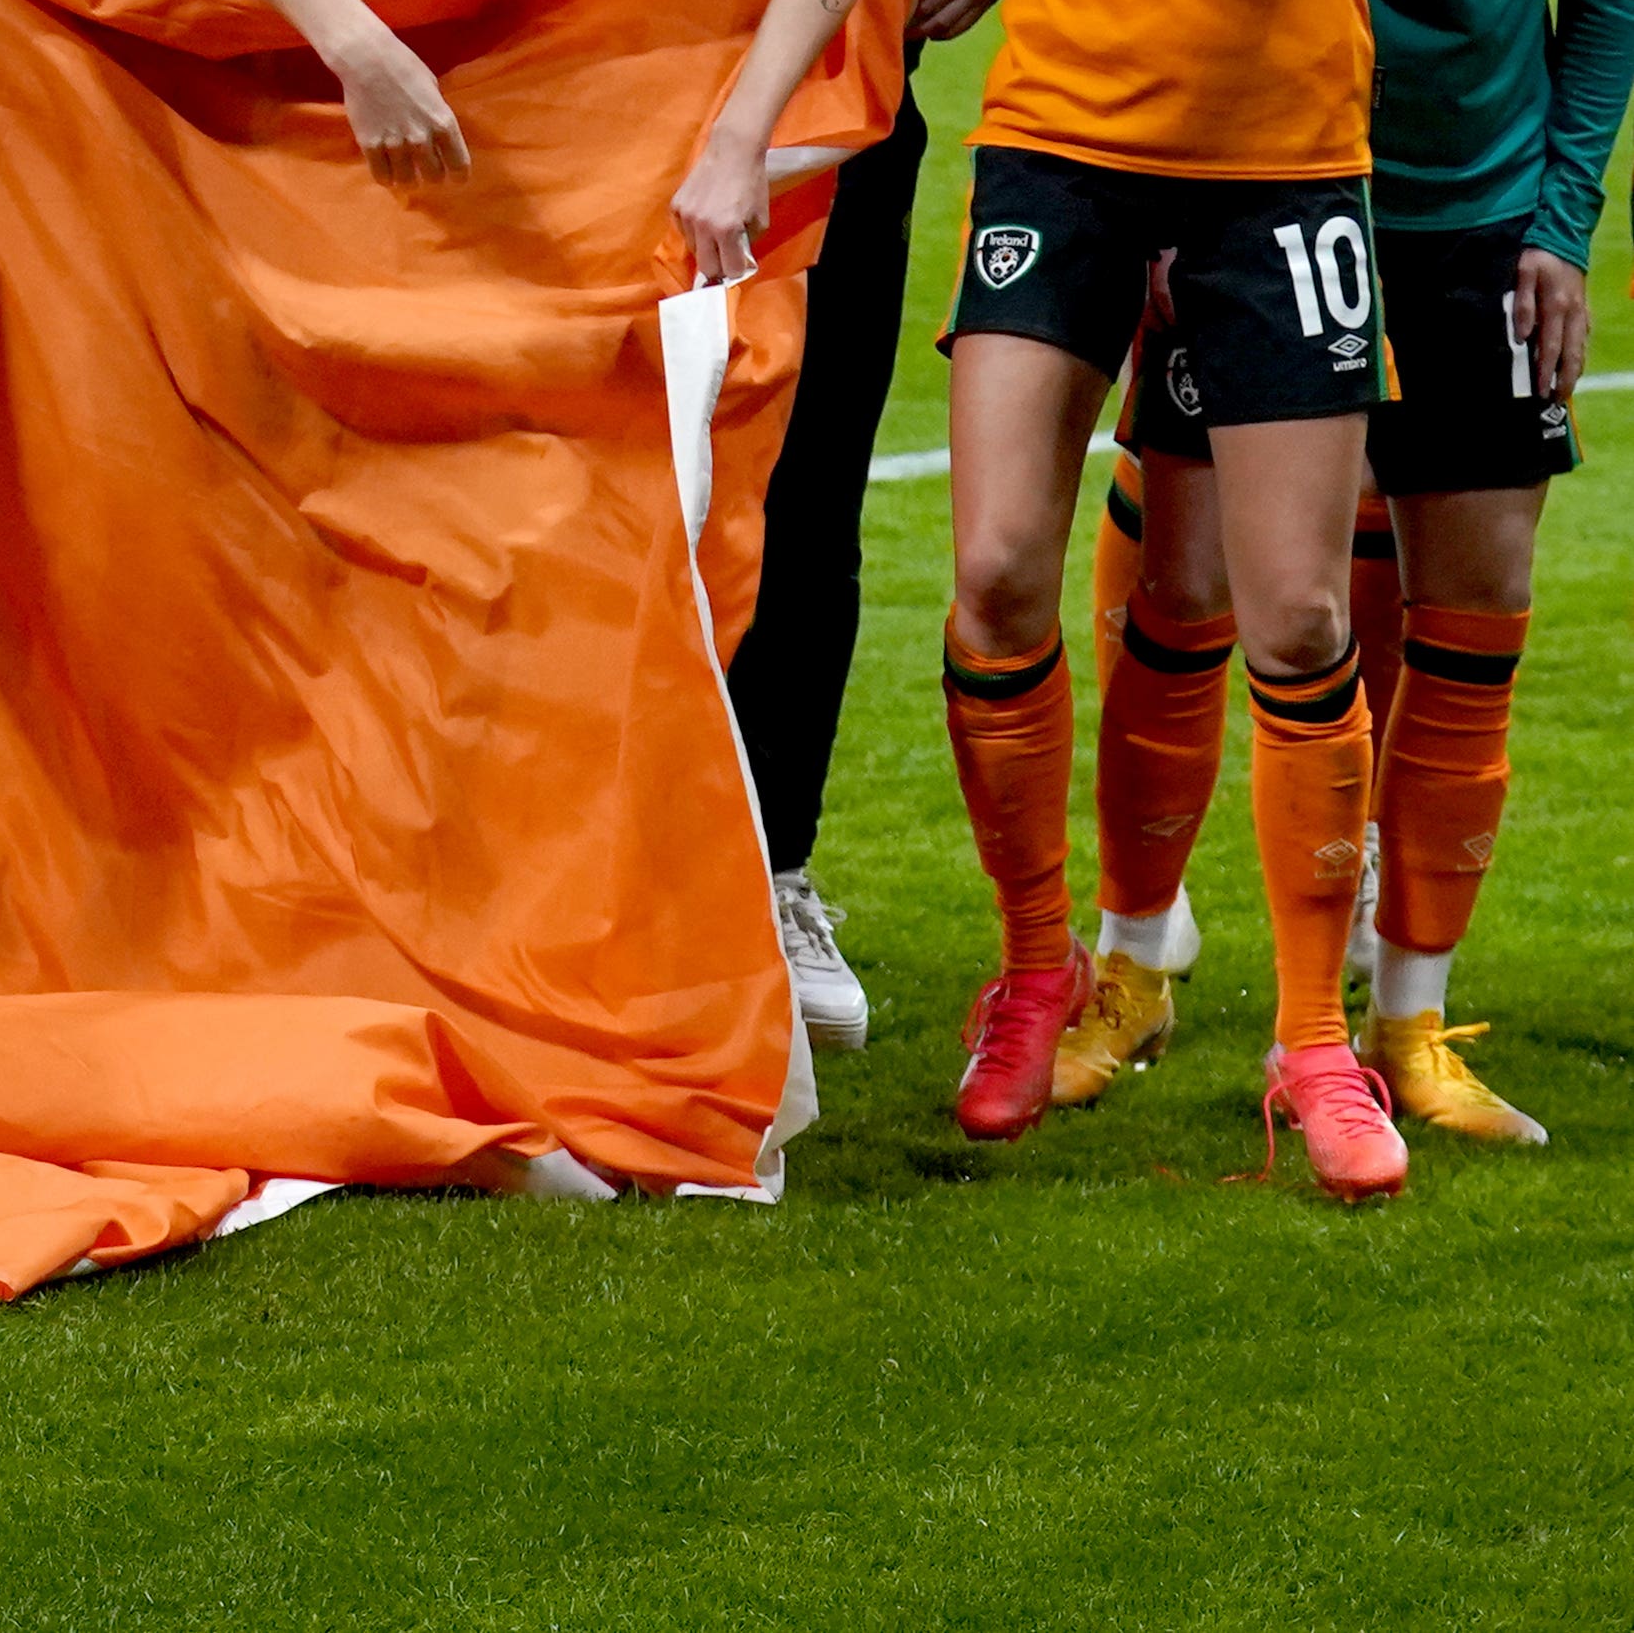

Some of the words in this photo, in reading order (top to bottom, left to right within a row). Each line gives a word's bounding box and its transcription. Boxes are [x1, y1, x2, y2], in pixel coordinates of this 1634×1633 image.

[989, 233, 1029, 247] Ireland
[1273, 216, 1372, 337] 10
[1333, 357, 1368, 372] umbro
